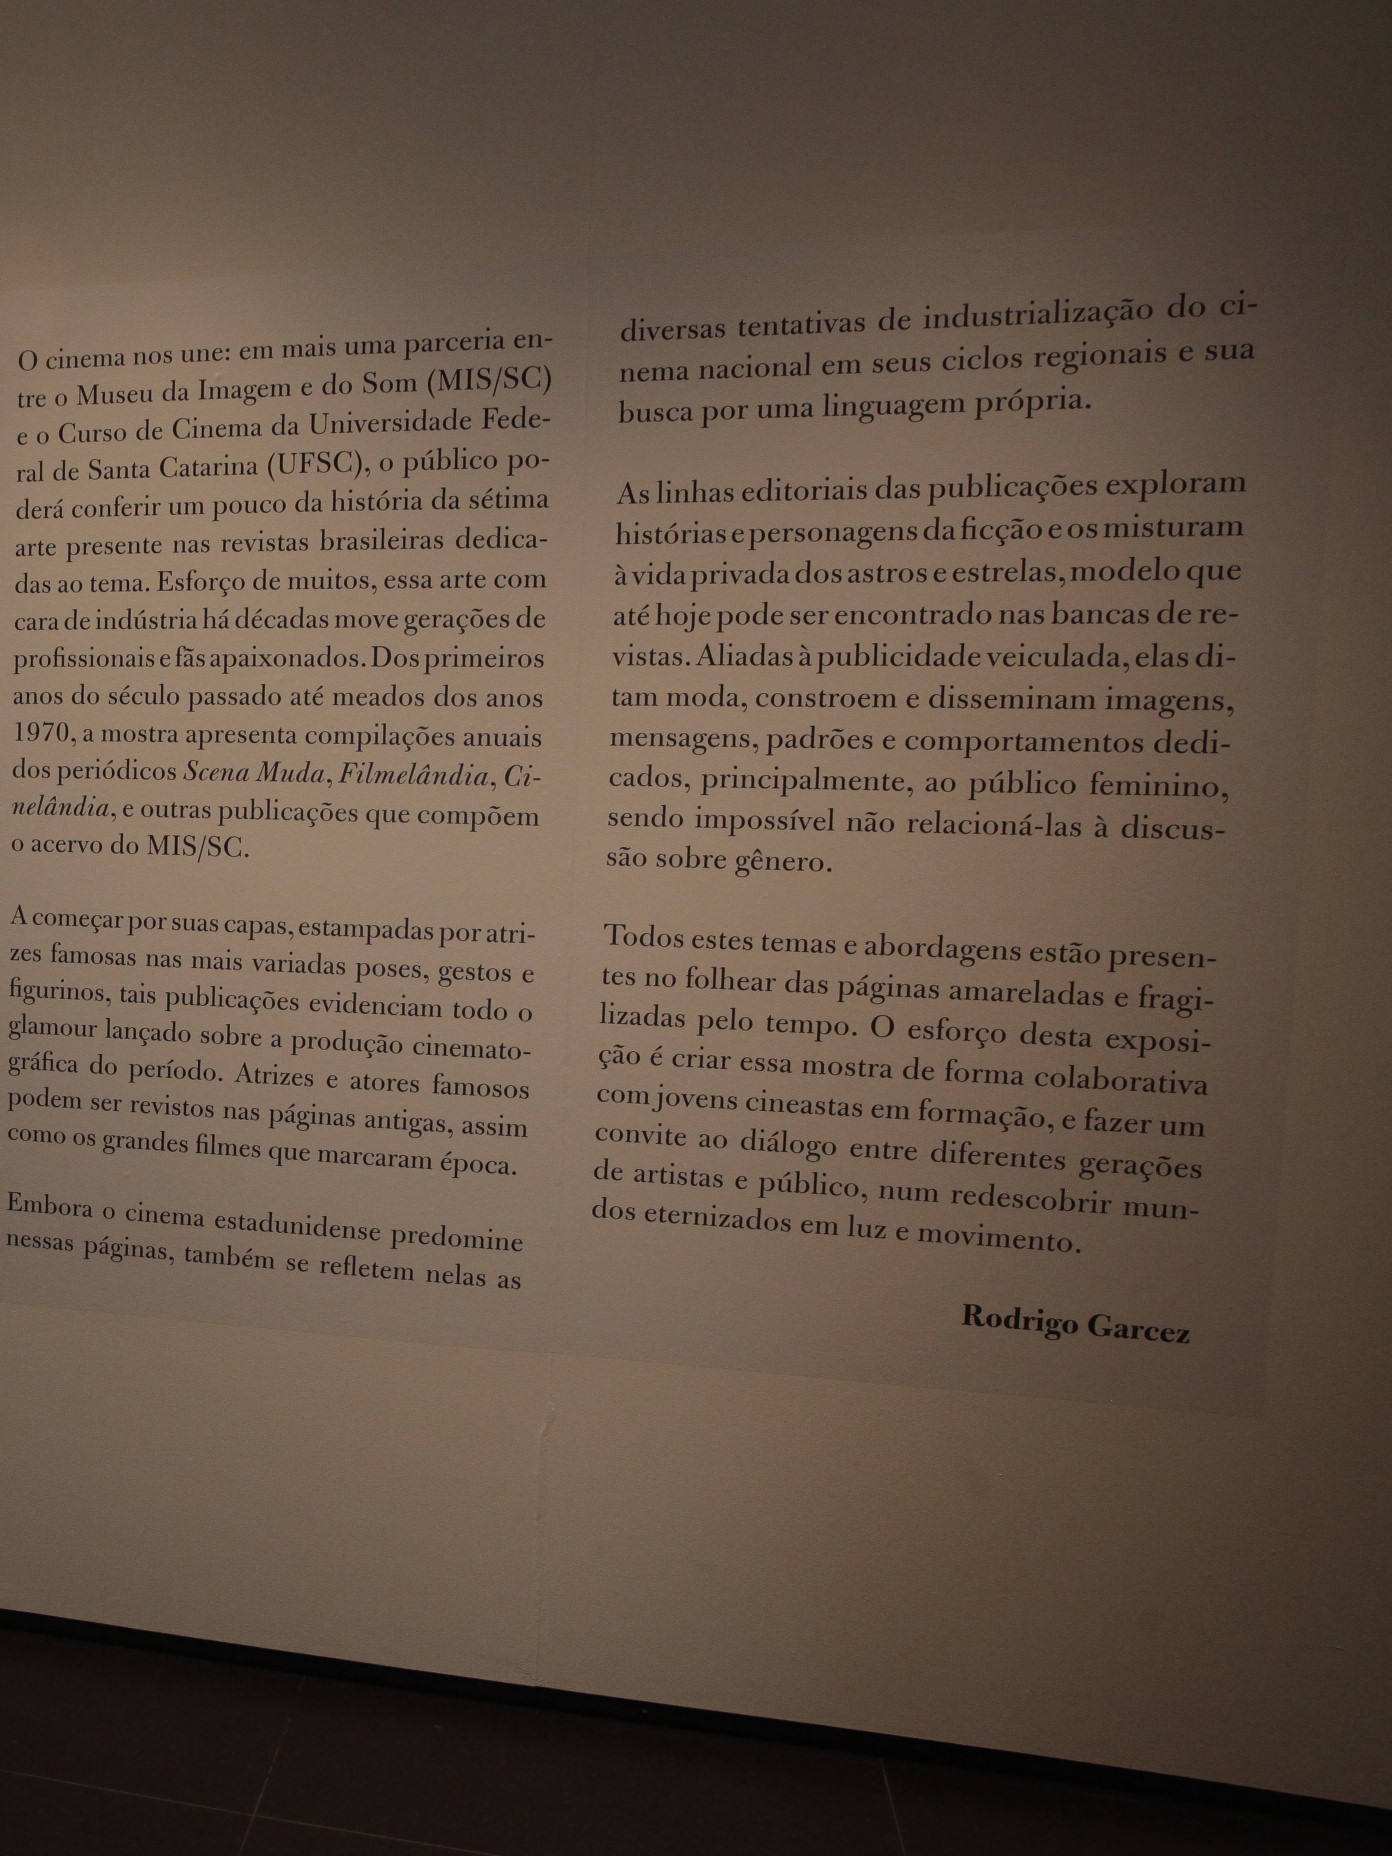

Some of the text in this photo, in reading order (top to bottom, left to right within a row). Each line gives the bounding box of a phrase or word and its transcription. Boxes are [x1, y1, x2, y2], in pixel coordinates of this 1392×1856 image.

[18, 326, 553, 371] O cinema nos une: em mais uma parceria en-
[620, 338, 1255, 383] nema nacional em seus ciclos regionais e sua
[16, 405, 551, 446] e o Curso de Cinema da Universidade Fede-
[15, 485, 549, 522] derá conferir um pouco da história da sétima
[616, 468, 1247, 507] As linhas editoriais das publicações exploram
[14, 567, 547, 598] das ao tema. Esforço de muitos, essa arte com
[614, 555, 1242, 593] à vida privada dos astros e estrelas, modelo que
[612, 642, 1236, 675] vistas. Aliadas à publicidade veiculada, elas di-
[16, 721, 542, 753] 1970, a mostra apresenta compilações anuais
[610, 724, 1231, 759] mensagens, padrões e comportamentos dedi-
[12, 794, 539, 833] nelândia, e outras publicações que compõem
[607, 804, 1226, 841] sendo impossível não relacioná-las à discus-
[10, 904, 536, 949] A começar por suas capas, estampadas por atri-
[603, 923, 1217, 973] Todos estes temas e abordagens estão presen-
[9, 976, 533, 1022] figurinos, tais publicações evidenciam todo o
[599, 1001, 1211, 1059] lizadas pelo tempo. O esforço desta exposi-
[7, 1050, 530, 1100] gráfica do período. Atrizes e atores famosos
[7, 1127, 517, 1179] como os grandes filmes que marcaram época.
[593, 1157, 1200, 1220] de artistas e público, num redescobrir mun-
[6, 1233, 522, 1290] nessas páginas, também se refletem nelas as
[961, 1303, 1191, 1345] Rodrigo Garcez
